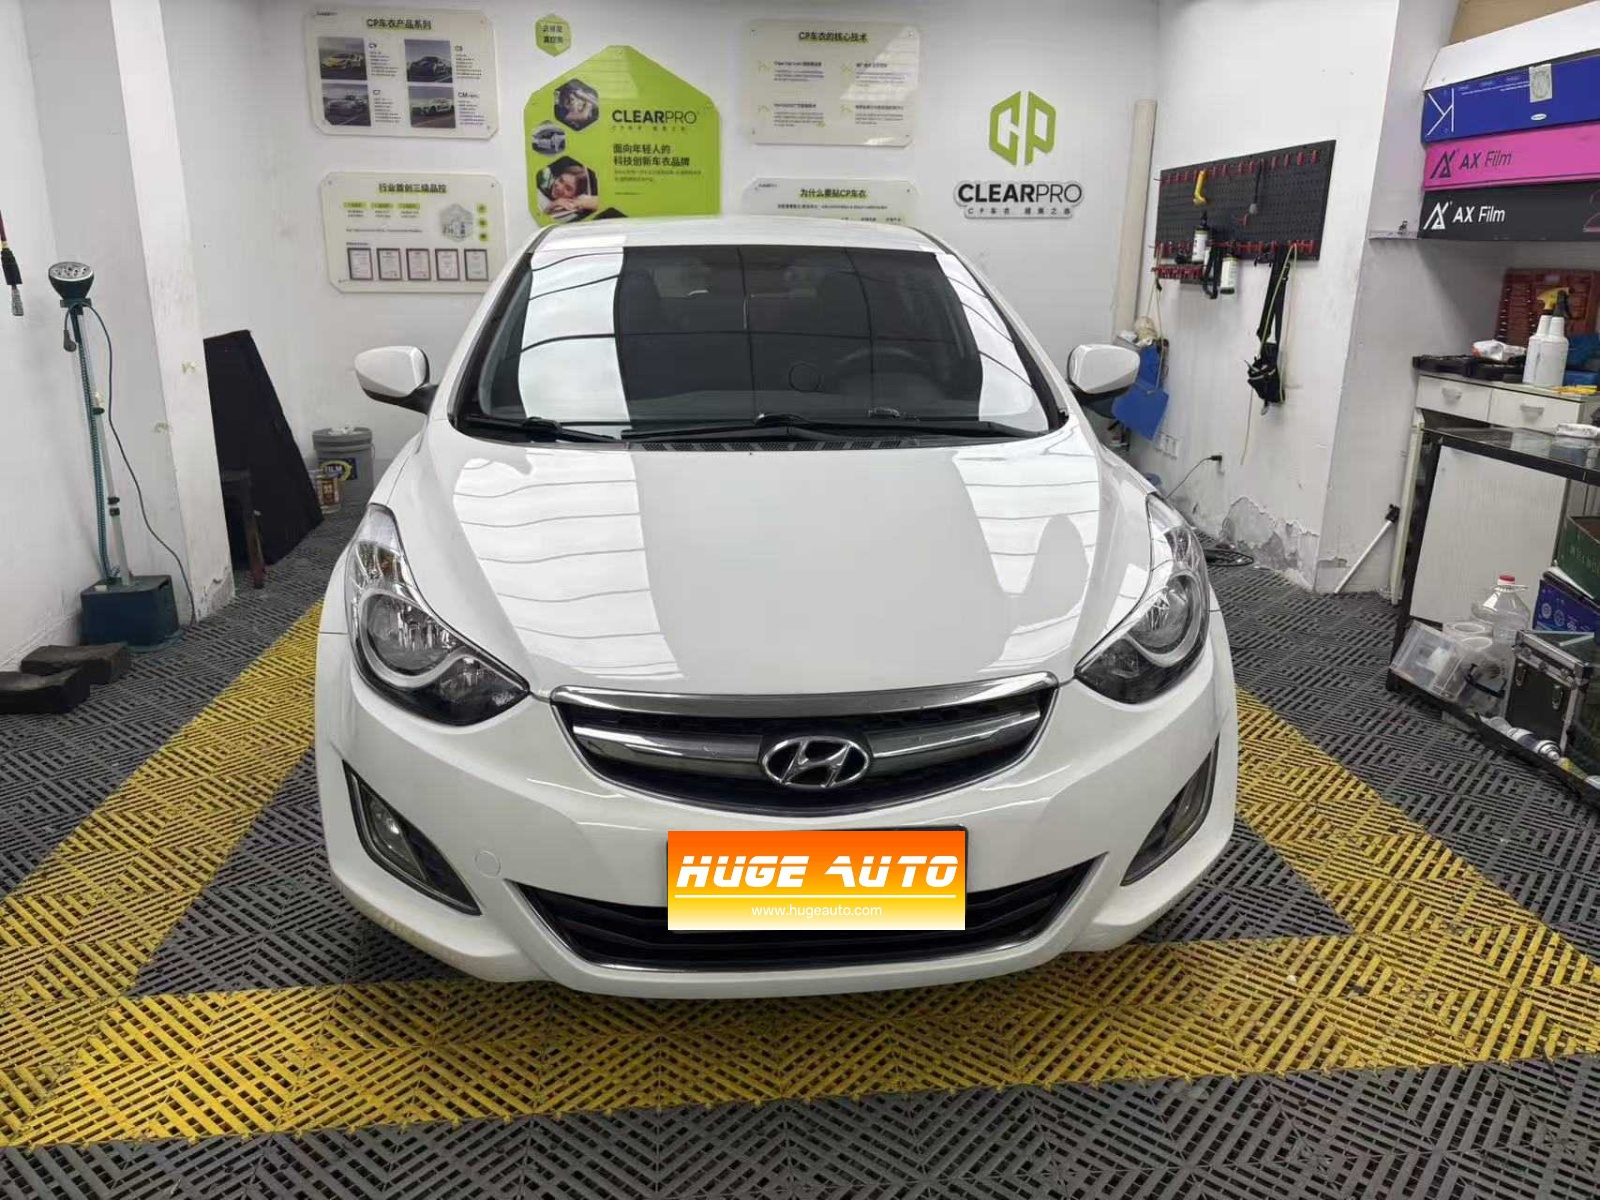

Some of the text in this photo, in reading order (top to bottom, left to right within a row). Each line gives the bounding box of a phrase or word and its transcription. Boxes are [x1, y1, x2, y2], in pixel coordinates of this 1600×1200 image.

[612, 110, 697, 124] CLEARPRO
[614, 143, 671, 154] 面向年轻人的
[614, 156, 690, 166] 科技创新车衣品牌
[1459, 149, 1513, 170] AX Film
[958, 183, 1082, 203] CLEARPRO
[1452, 204, 1506, 223] AX Film
